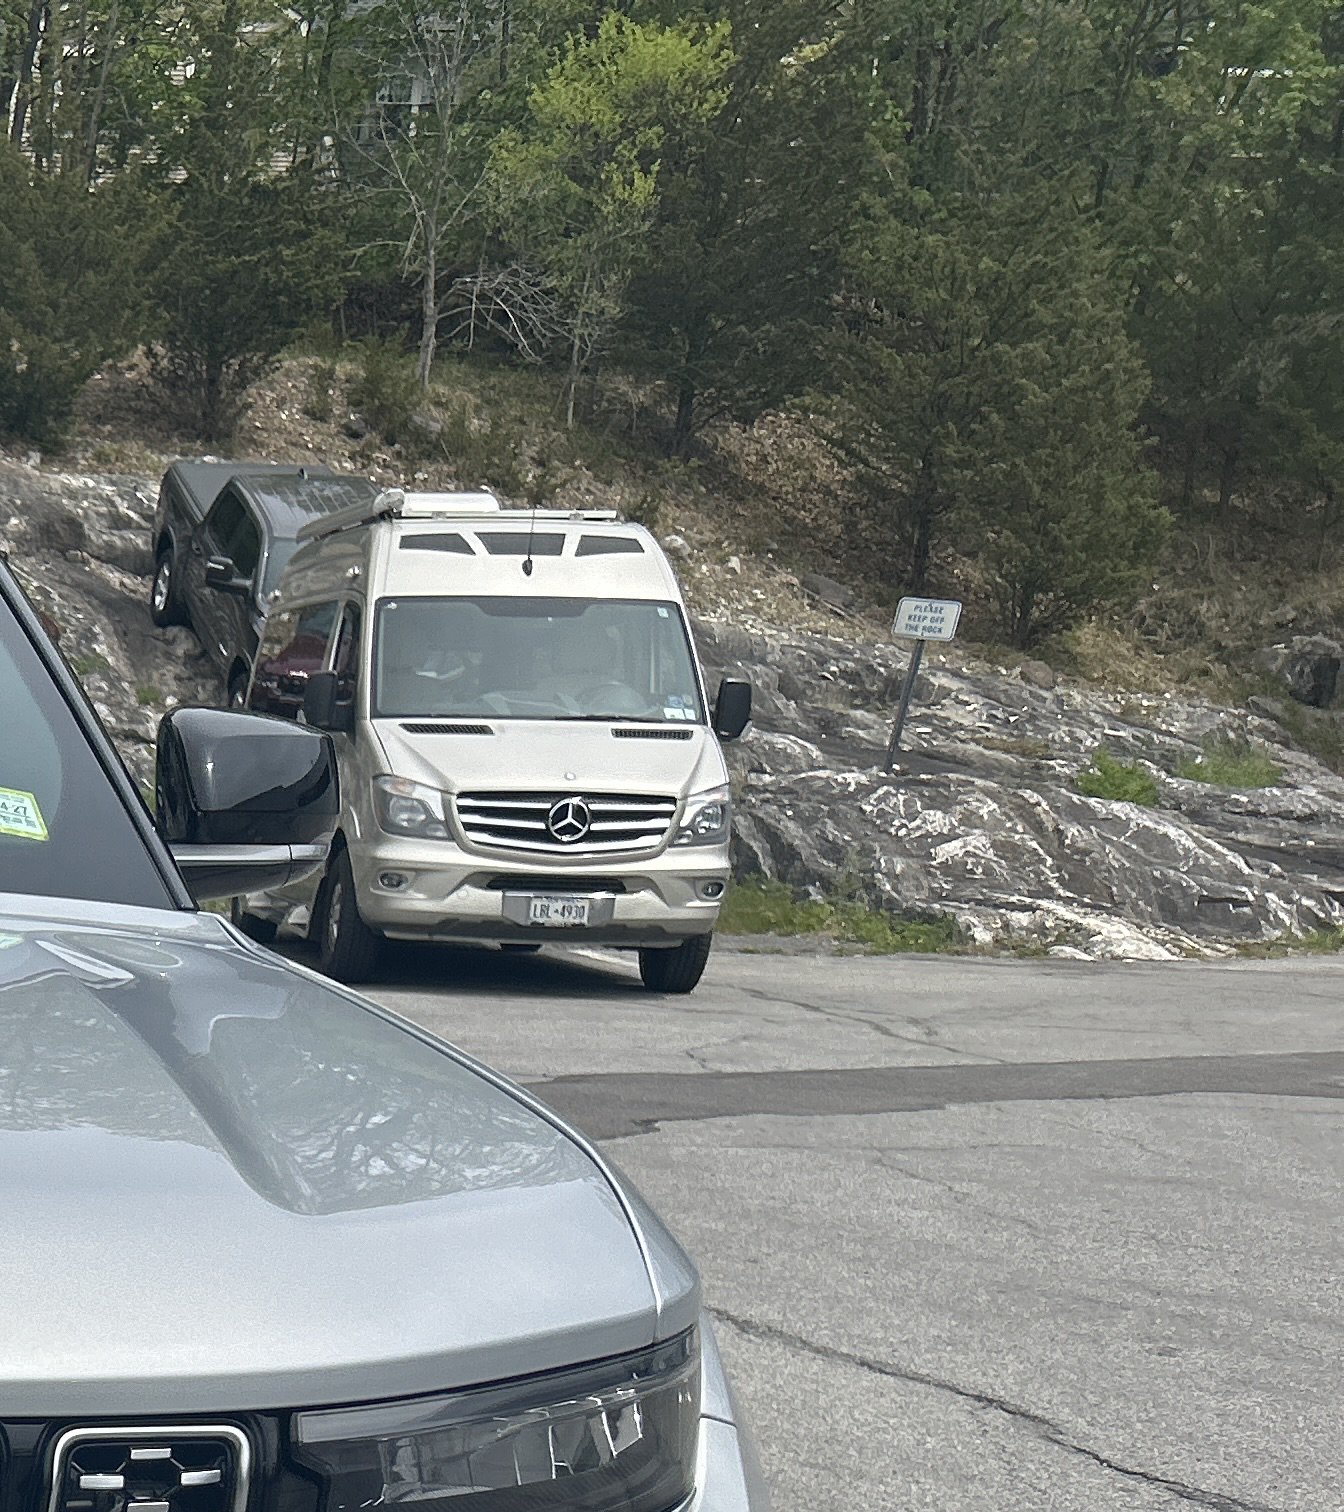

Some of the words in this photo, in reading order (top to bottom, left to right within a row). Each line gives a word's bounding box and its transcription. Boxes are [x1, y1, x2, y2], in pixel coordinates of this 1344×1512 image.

[914, 604, 945, 615] PLEASE
[907, 614, 929, 623] KEEP
[929, 616, 945, 625] OFF
[904, 623, 919, 632] THE
[921, 625, 943, 634] ROCK
